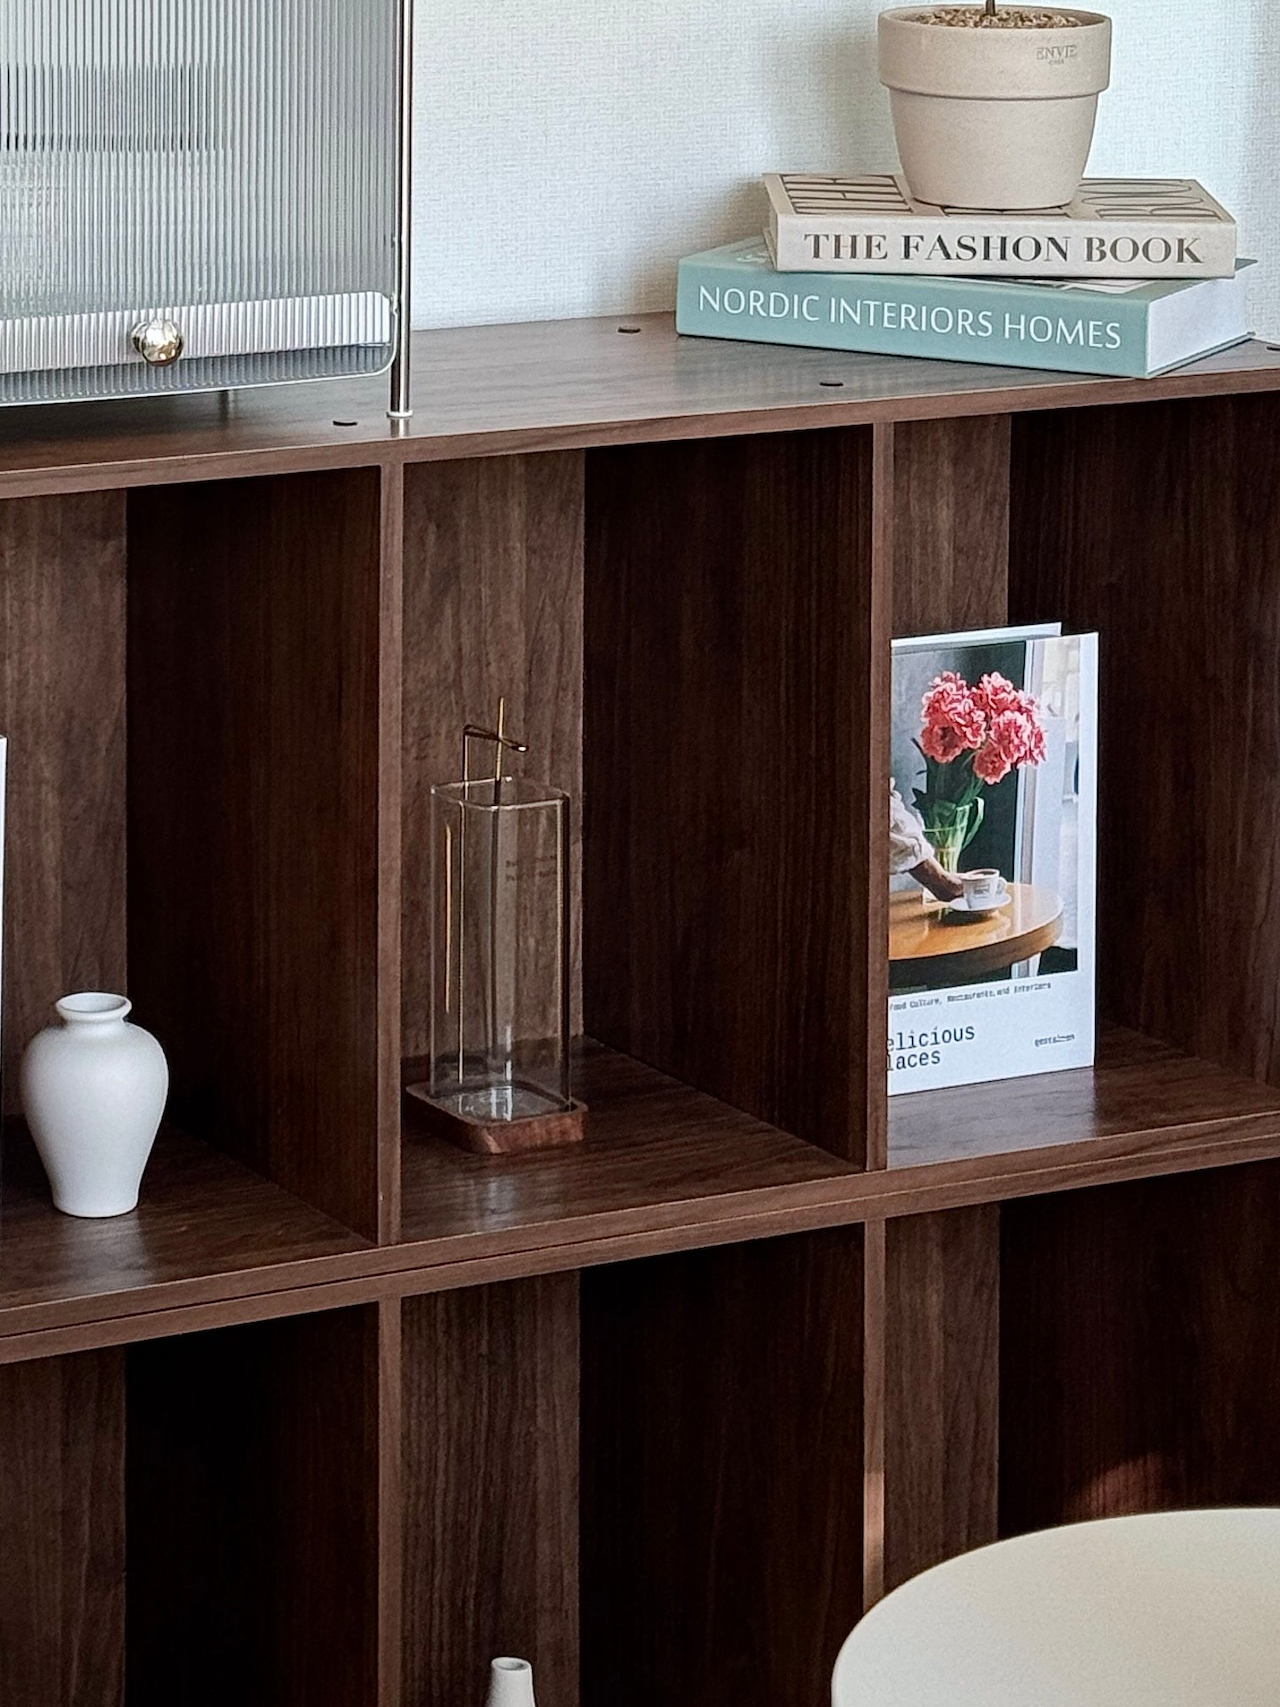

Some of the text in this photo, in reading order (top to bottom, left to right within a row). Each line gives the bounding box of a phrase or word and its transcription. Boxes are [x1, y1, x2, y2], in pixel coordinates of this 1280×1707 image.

[804, 233, 1204, 265] THE FASHON BOOK
[698, 285, 1122, 350] NORDIC INTERIORS HOMES
[888, 1025, 975, 1052] elicious
[887, 1049, 941, 1072] laces
